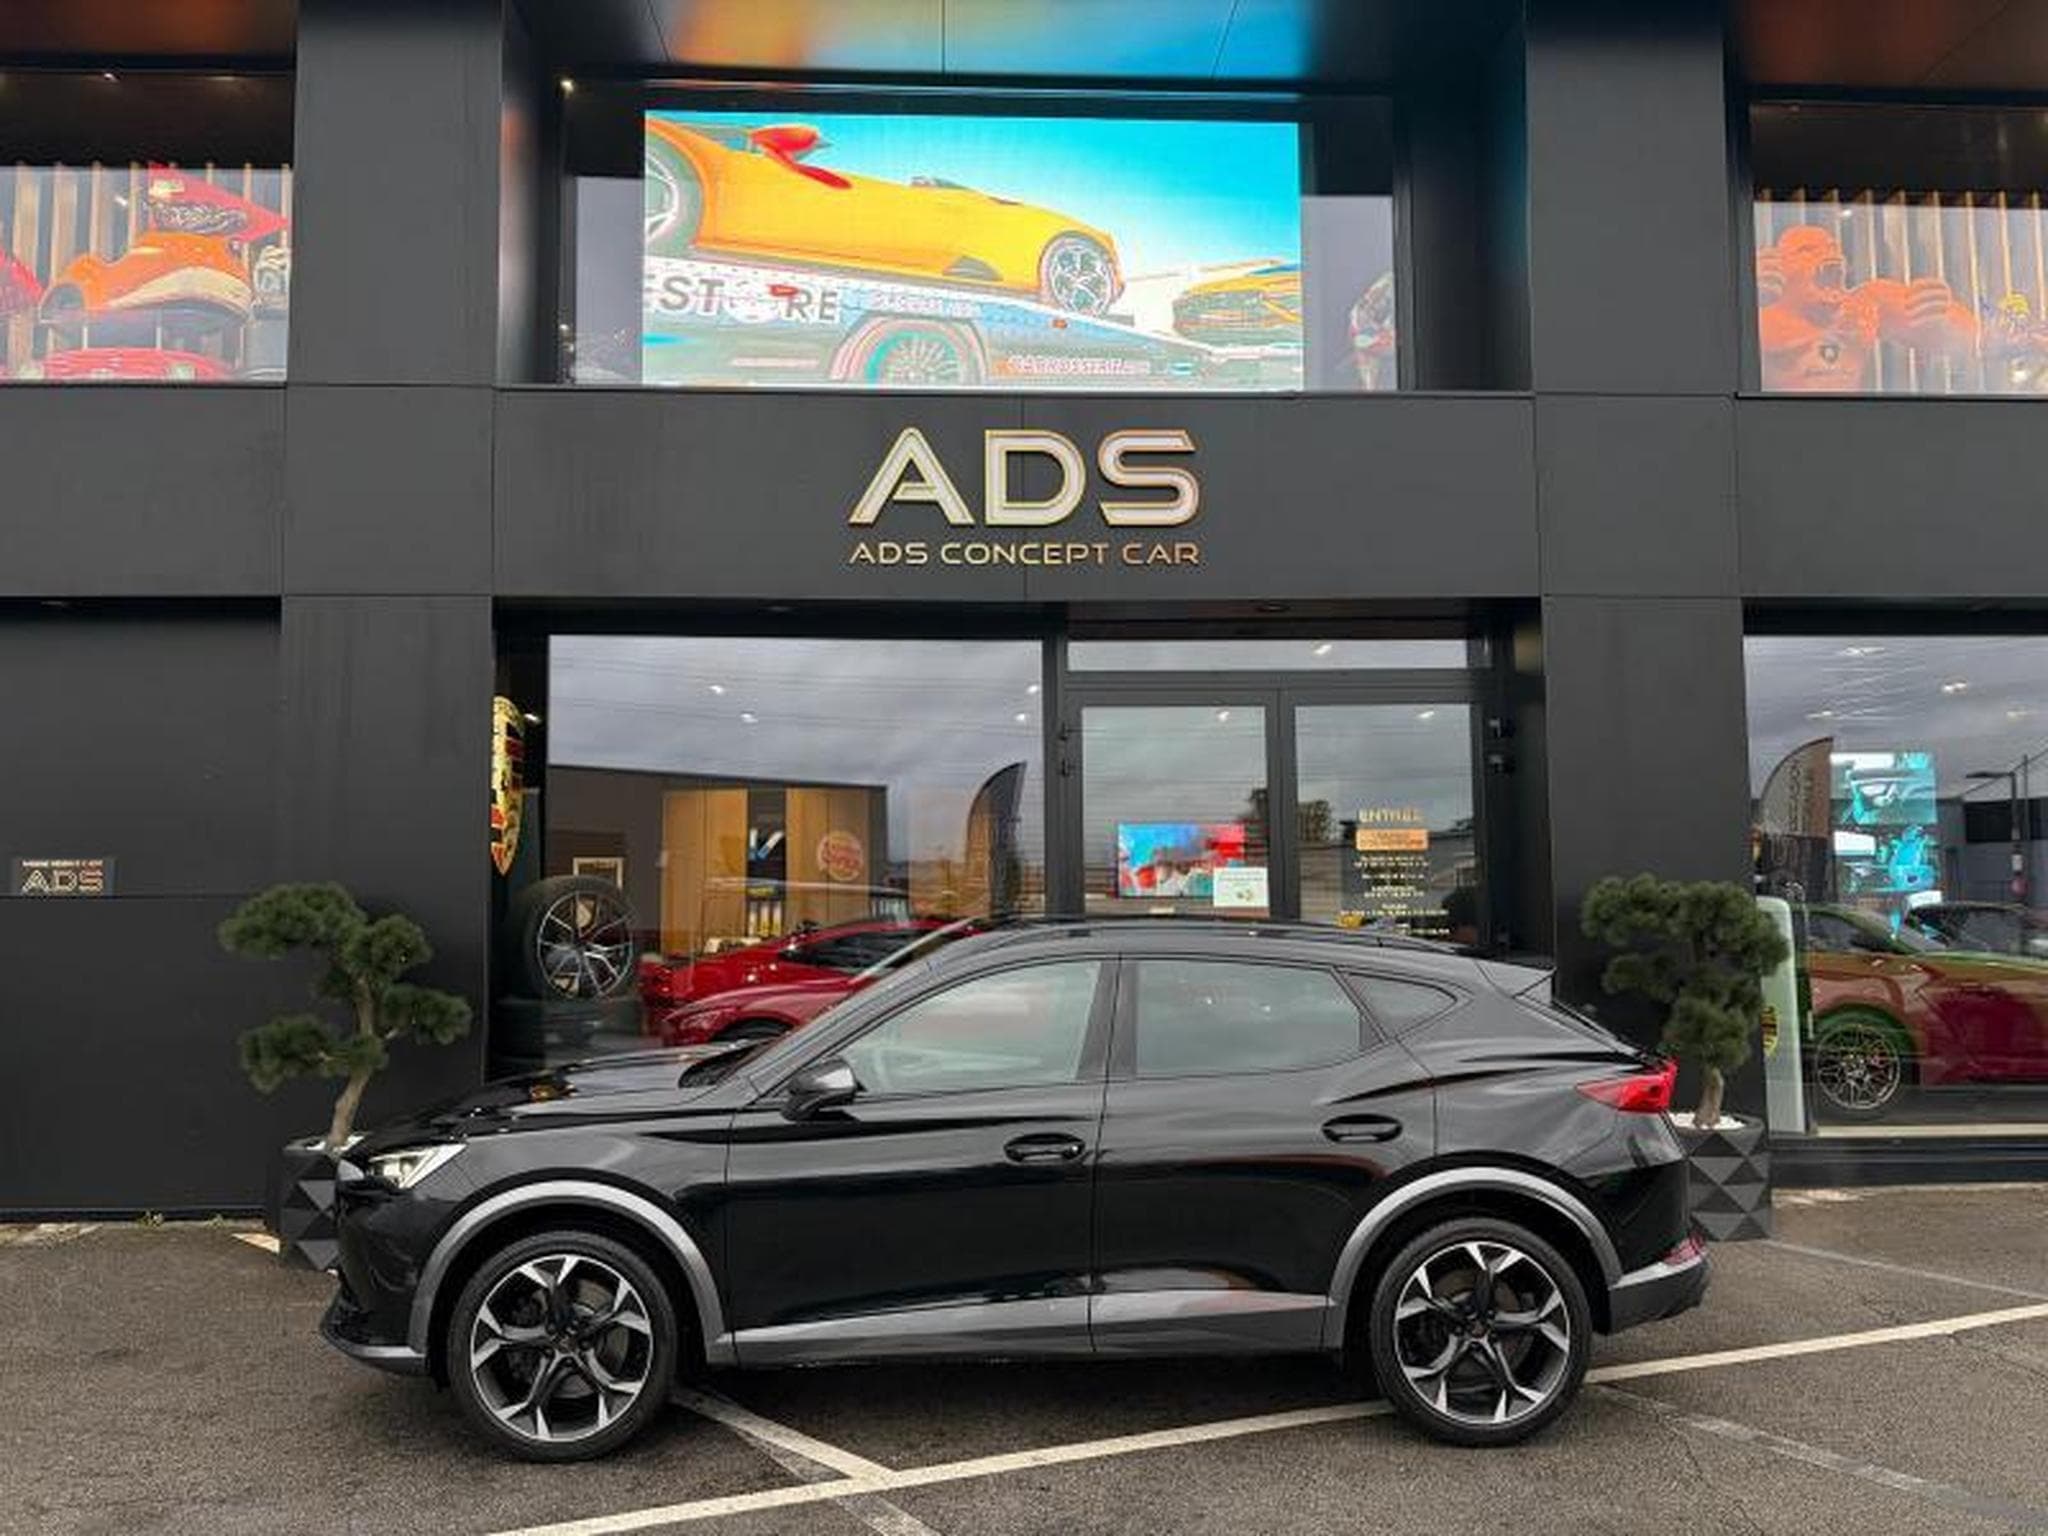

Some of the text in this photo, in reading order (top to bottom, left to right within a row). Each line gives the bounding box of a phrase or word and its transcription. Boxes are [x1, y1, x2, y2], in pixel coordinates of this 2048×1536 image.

[848, 427, 1201, 527] ADS
[849, 543, 1200, 565] ADS CONCEPT CAR
[21, 869, 103, 893] ADS
